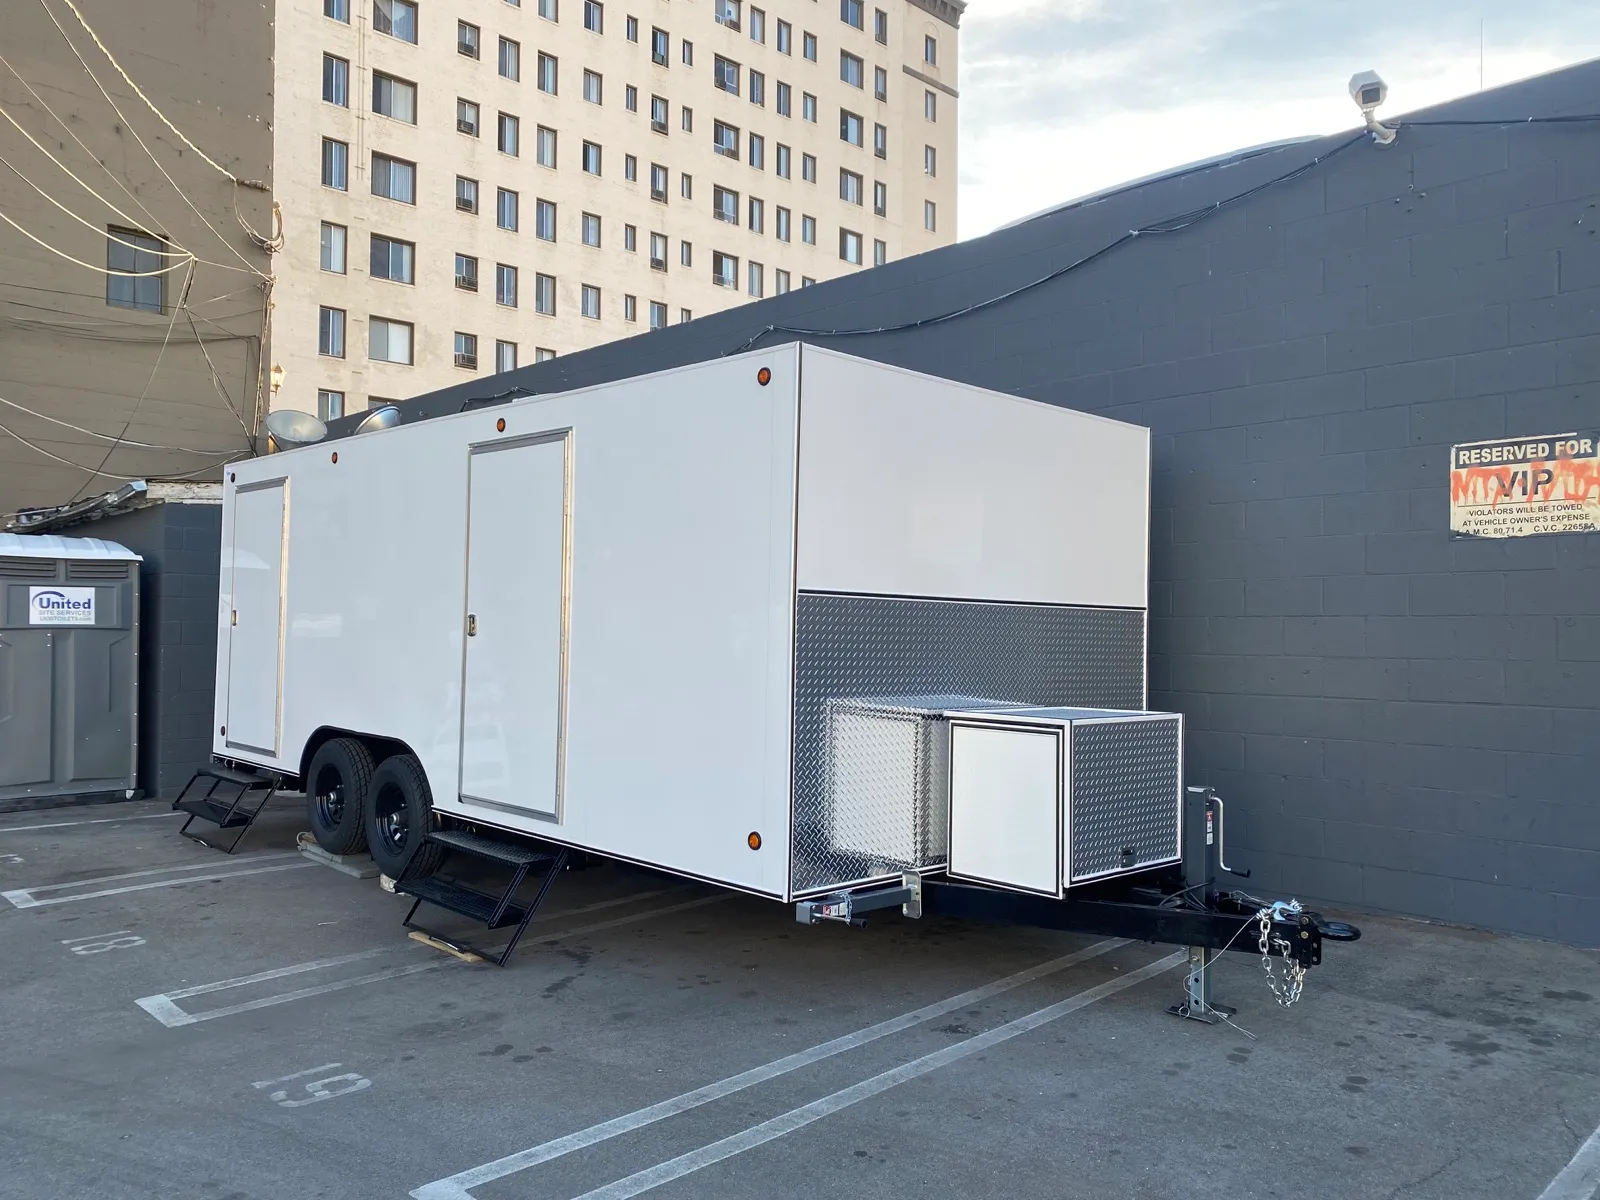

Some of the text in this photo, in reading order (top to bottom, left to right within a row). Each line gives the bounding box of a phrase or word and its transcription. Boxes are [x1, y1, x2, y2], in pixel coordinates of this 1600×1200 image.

[1459, 438, 1593, 465] RESERVED FOR
[1496, 468, 1554, 497] VIP
[1468, 503, 1583, 517] VIOLATORS WILL BE TOWED
[1474, 517, 1508, 526] VEHICLE
[1509, 515, 1549, 525] OWNER'S
[1550, 513, 1591, 522] EXPENSE
[39, 597, 91, 610] United
